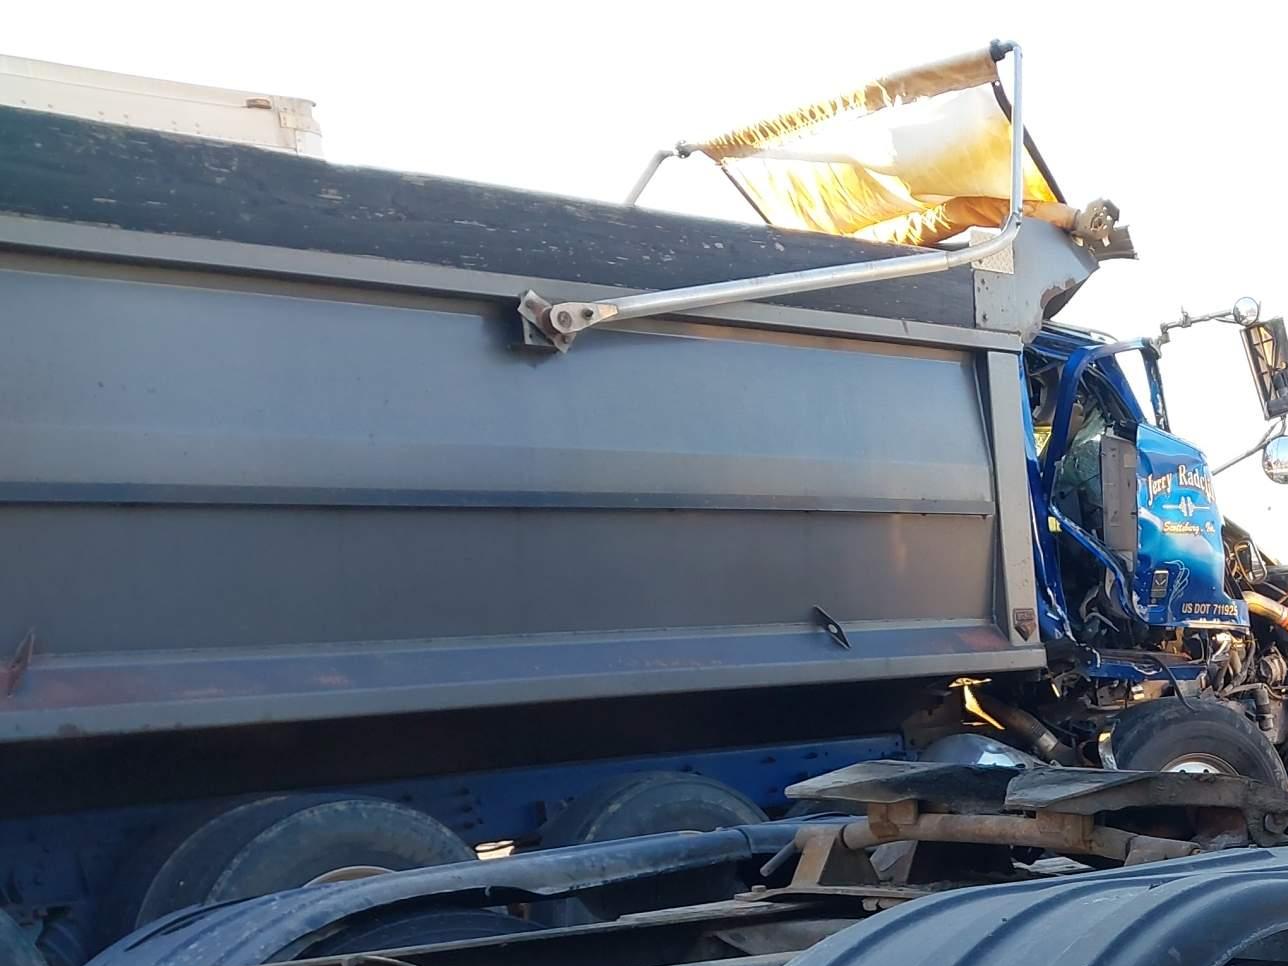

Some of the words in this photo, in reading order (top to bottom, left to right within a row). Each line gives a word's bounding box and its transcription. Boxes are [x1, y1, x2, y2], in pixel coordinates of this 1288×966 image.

[1148, 473, 1173, 506] Jerry
[1181, 603, 1193, 614] US
[1194, 603, 1211, 615] DOT
